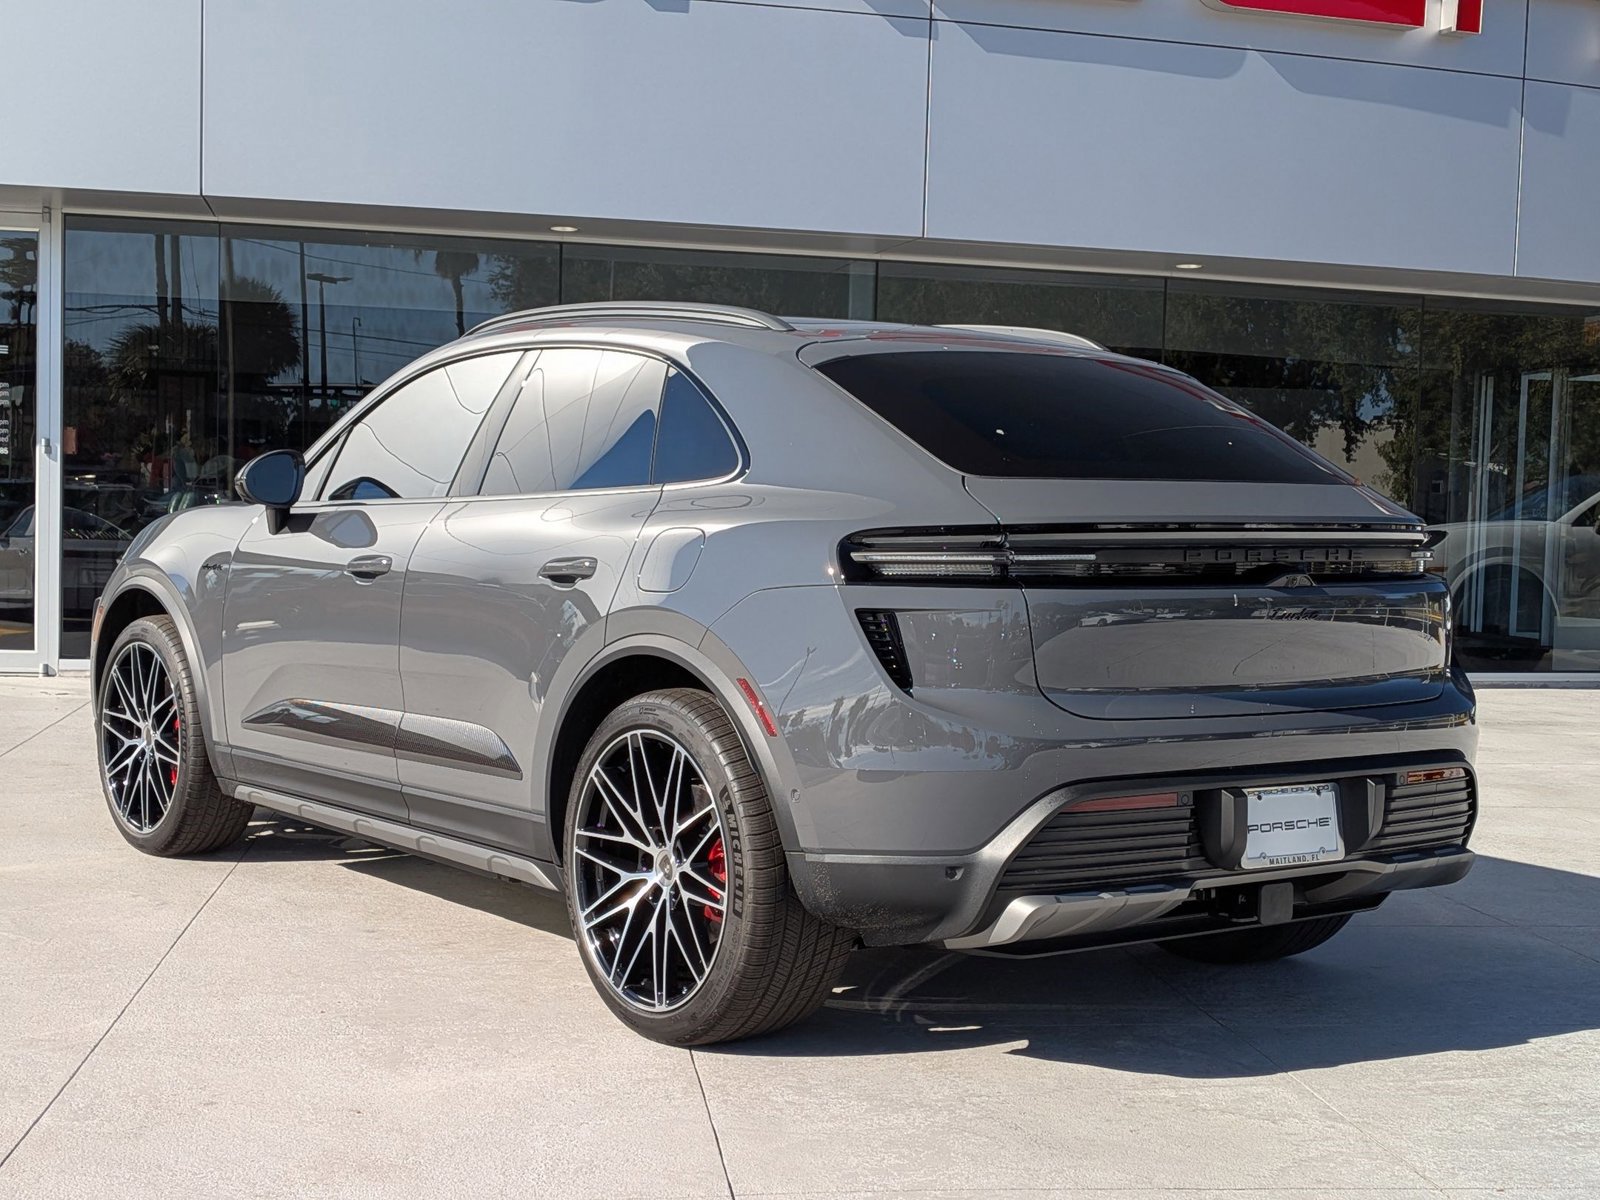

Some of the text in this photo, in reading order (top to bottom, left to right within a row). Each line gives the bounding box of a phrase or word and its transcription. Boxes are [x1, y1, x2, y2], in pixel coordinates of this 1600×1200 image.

[1184, 549, 1363, 562] PORSCHE
[1248, 784, 1330, 796] PORSCHE ORLANDO
[1247, 817, 1331, 834] PORSCHE
[726, 813, 743, 914] MICHELIN
